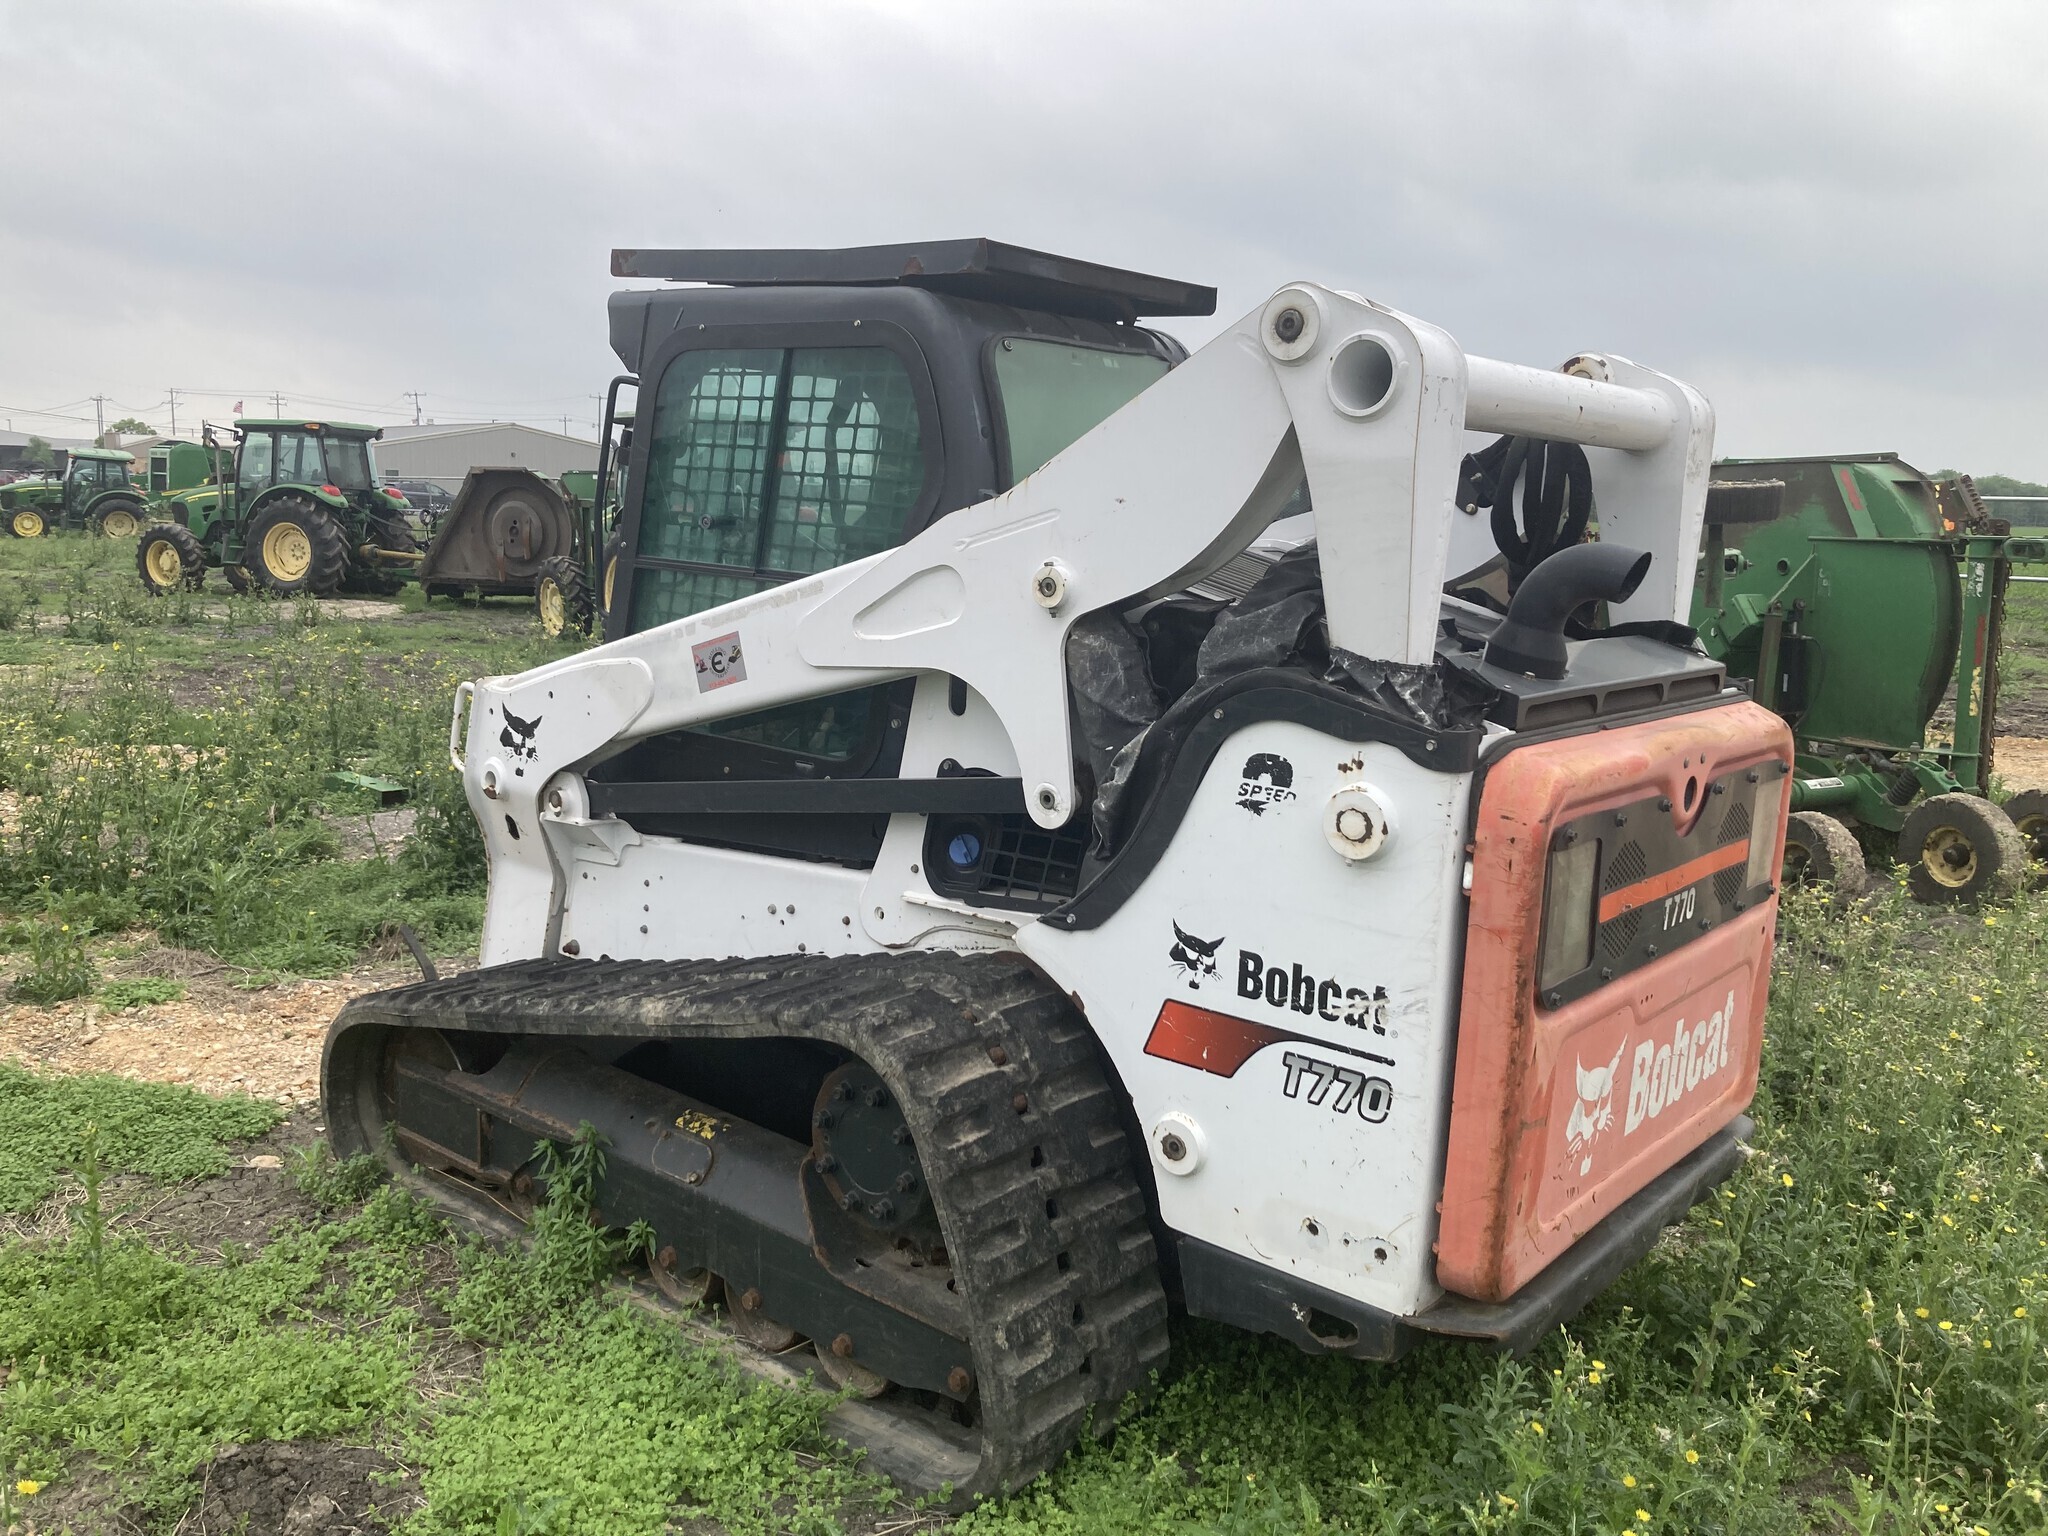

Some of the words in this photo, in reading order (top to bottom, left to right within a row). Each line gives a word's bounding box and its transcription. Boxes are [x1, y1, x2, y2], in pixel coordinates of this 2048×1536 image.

[1663, 887, 1696, 931] T770
[1236, 949, 1391, 1037] Bobcat
[1282, 1051, 1394, 1124] T770
[1624, 990, 1735, 1137] Bobcat
